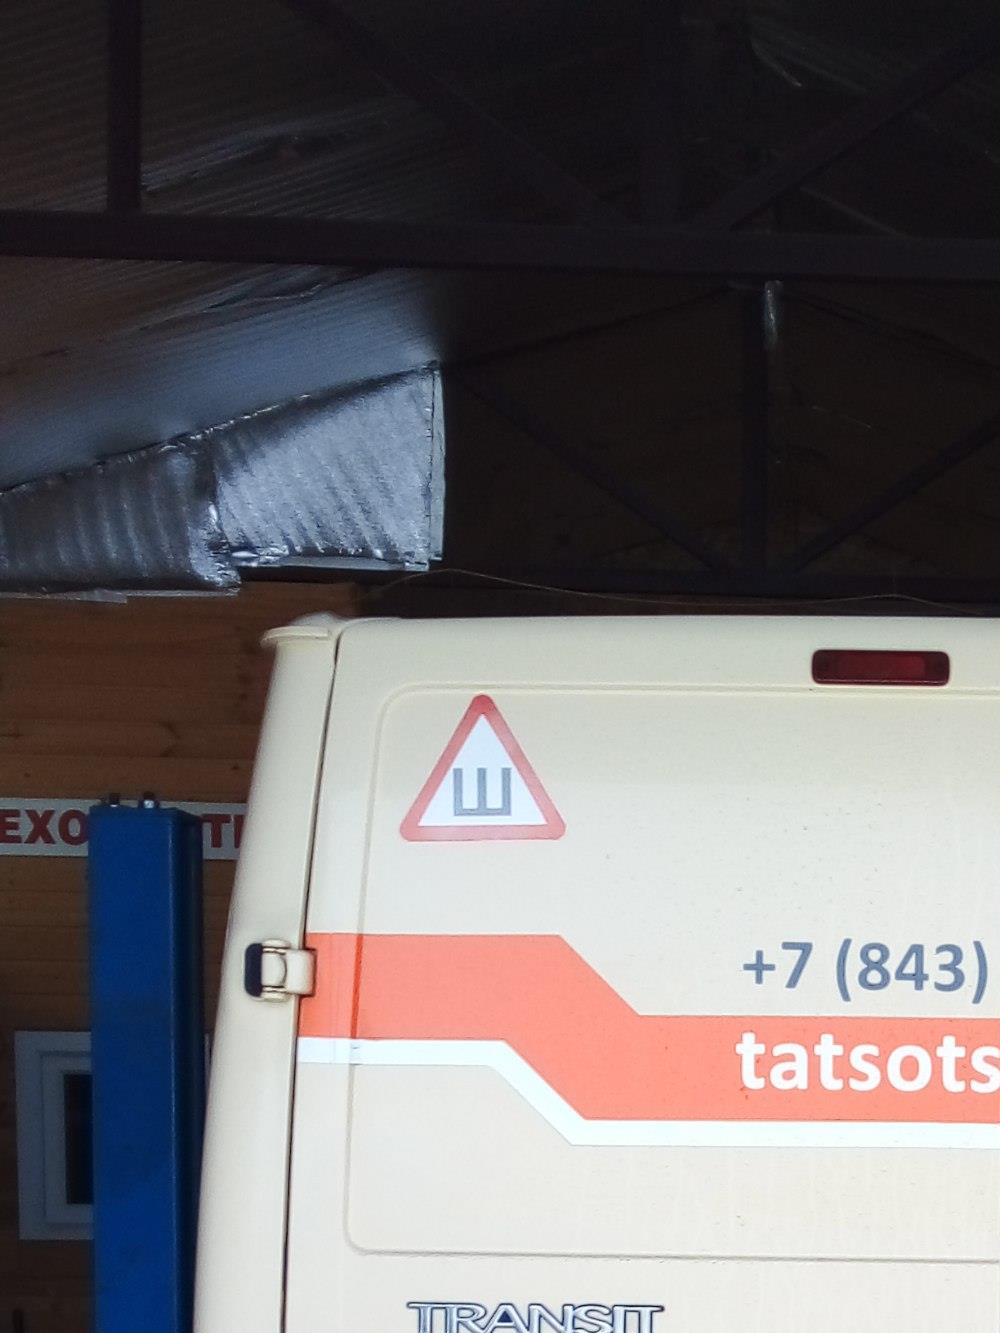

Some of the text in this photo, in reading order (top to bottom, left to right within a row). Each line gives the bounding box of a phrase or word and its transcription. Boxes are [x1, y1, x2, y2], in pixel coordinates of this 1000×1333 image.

[453, 767, 512, 817] Ш
[743, 941, 813, 990] +7
[836, 939, 989, 1004] (843)
